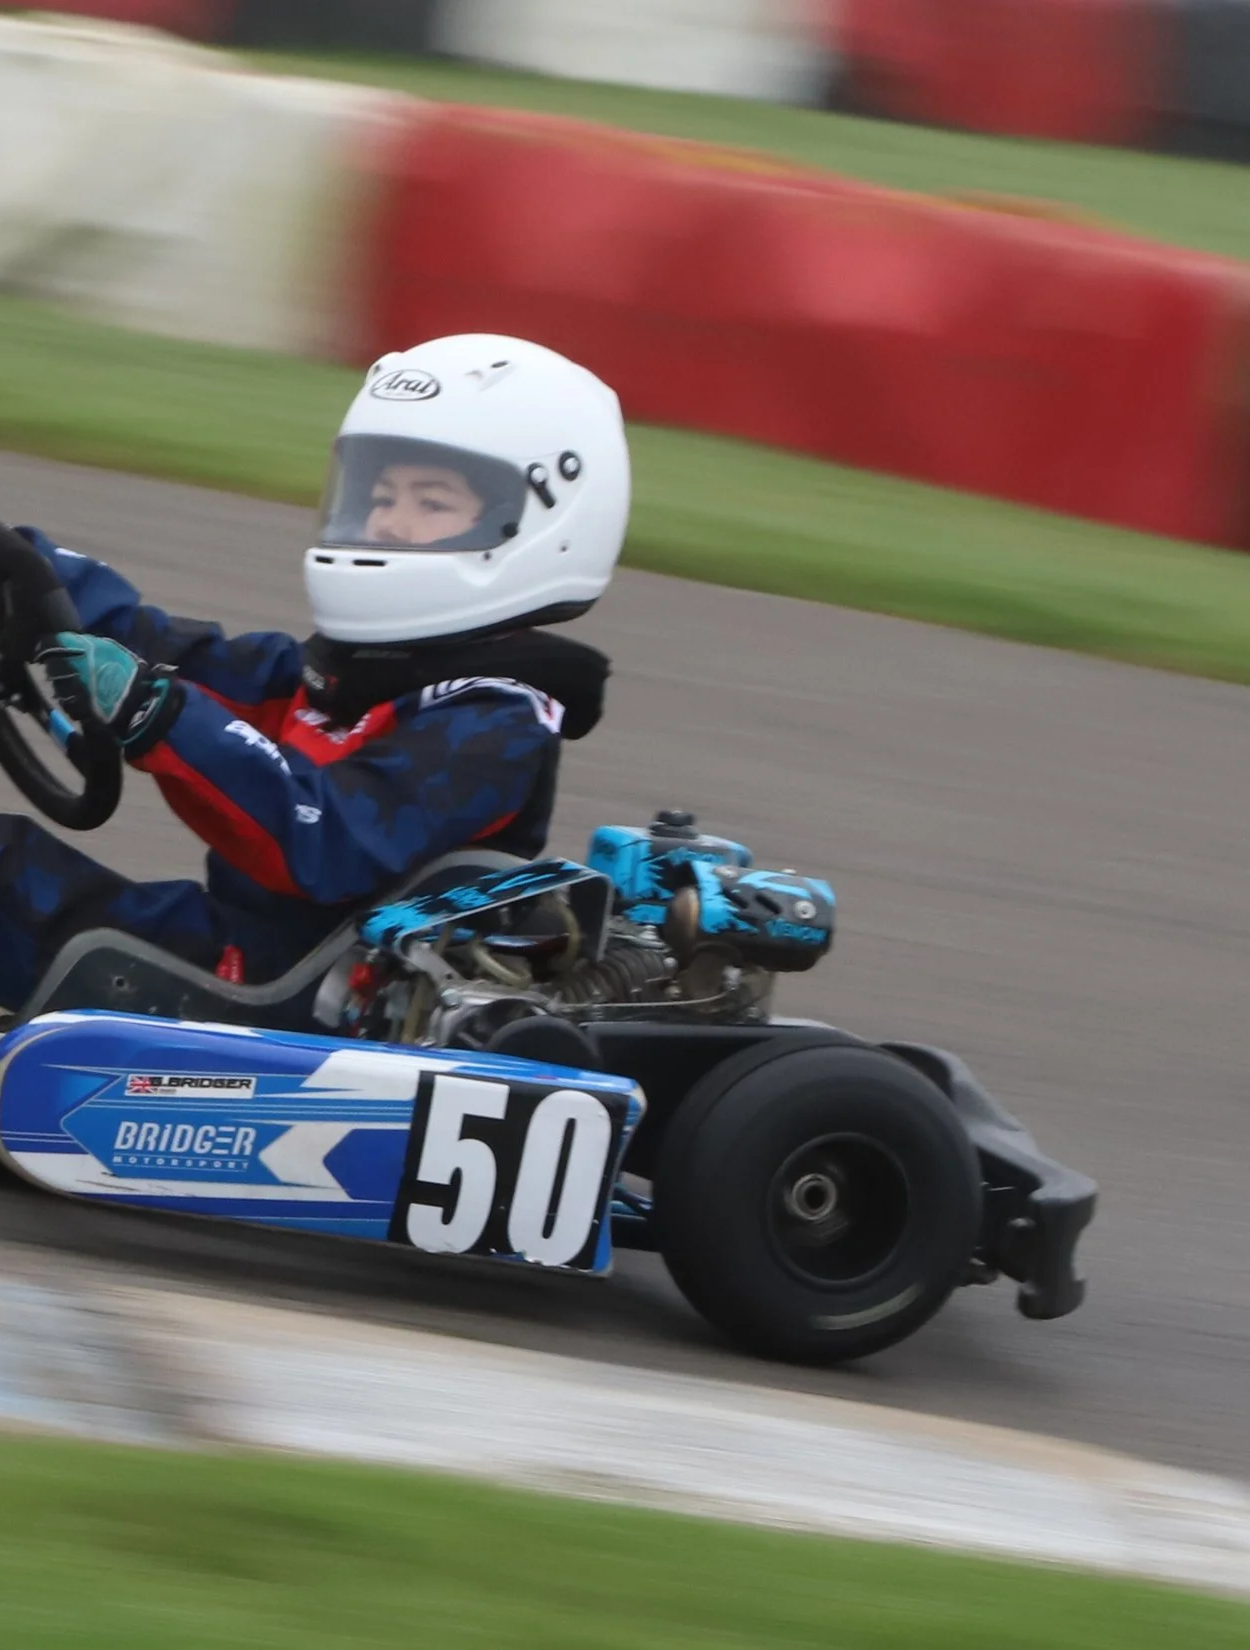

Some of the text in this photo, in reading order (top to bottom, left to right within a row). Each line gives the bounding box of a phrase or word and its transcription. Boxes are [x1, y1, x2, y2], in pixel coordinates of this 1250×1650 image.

[371, 371, 433, 394] Arai
[114, 1121, 257, 1156] BRIDGER
[112, 1155, 249, 1170] MOTORSPORT
[406, 1074, 612, 1267] 50
